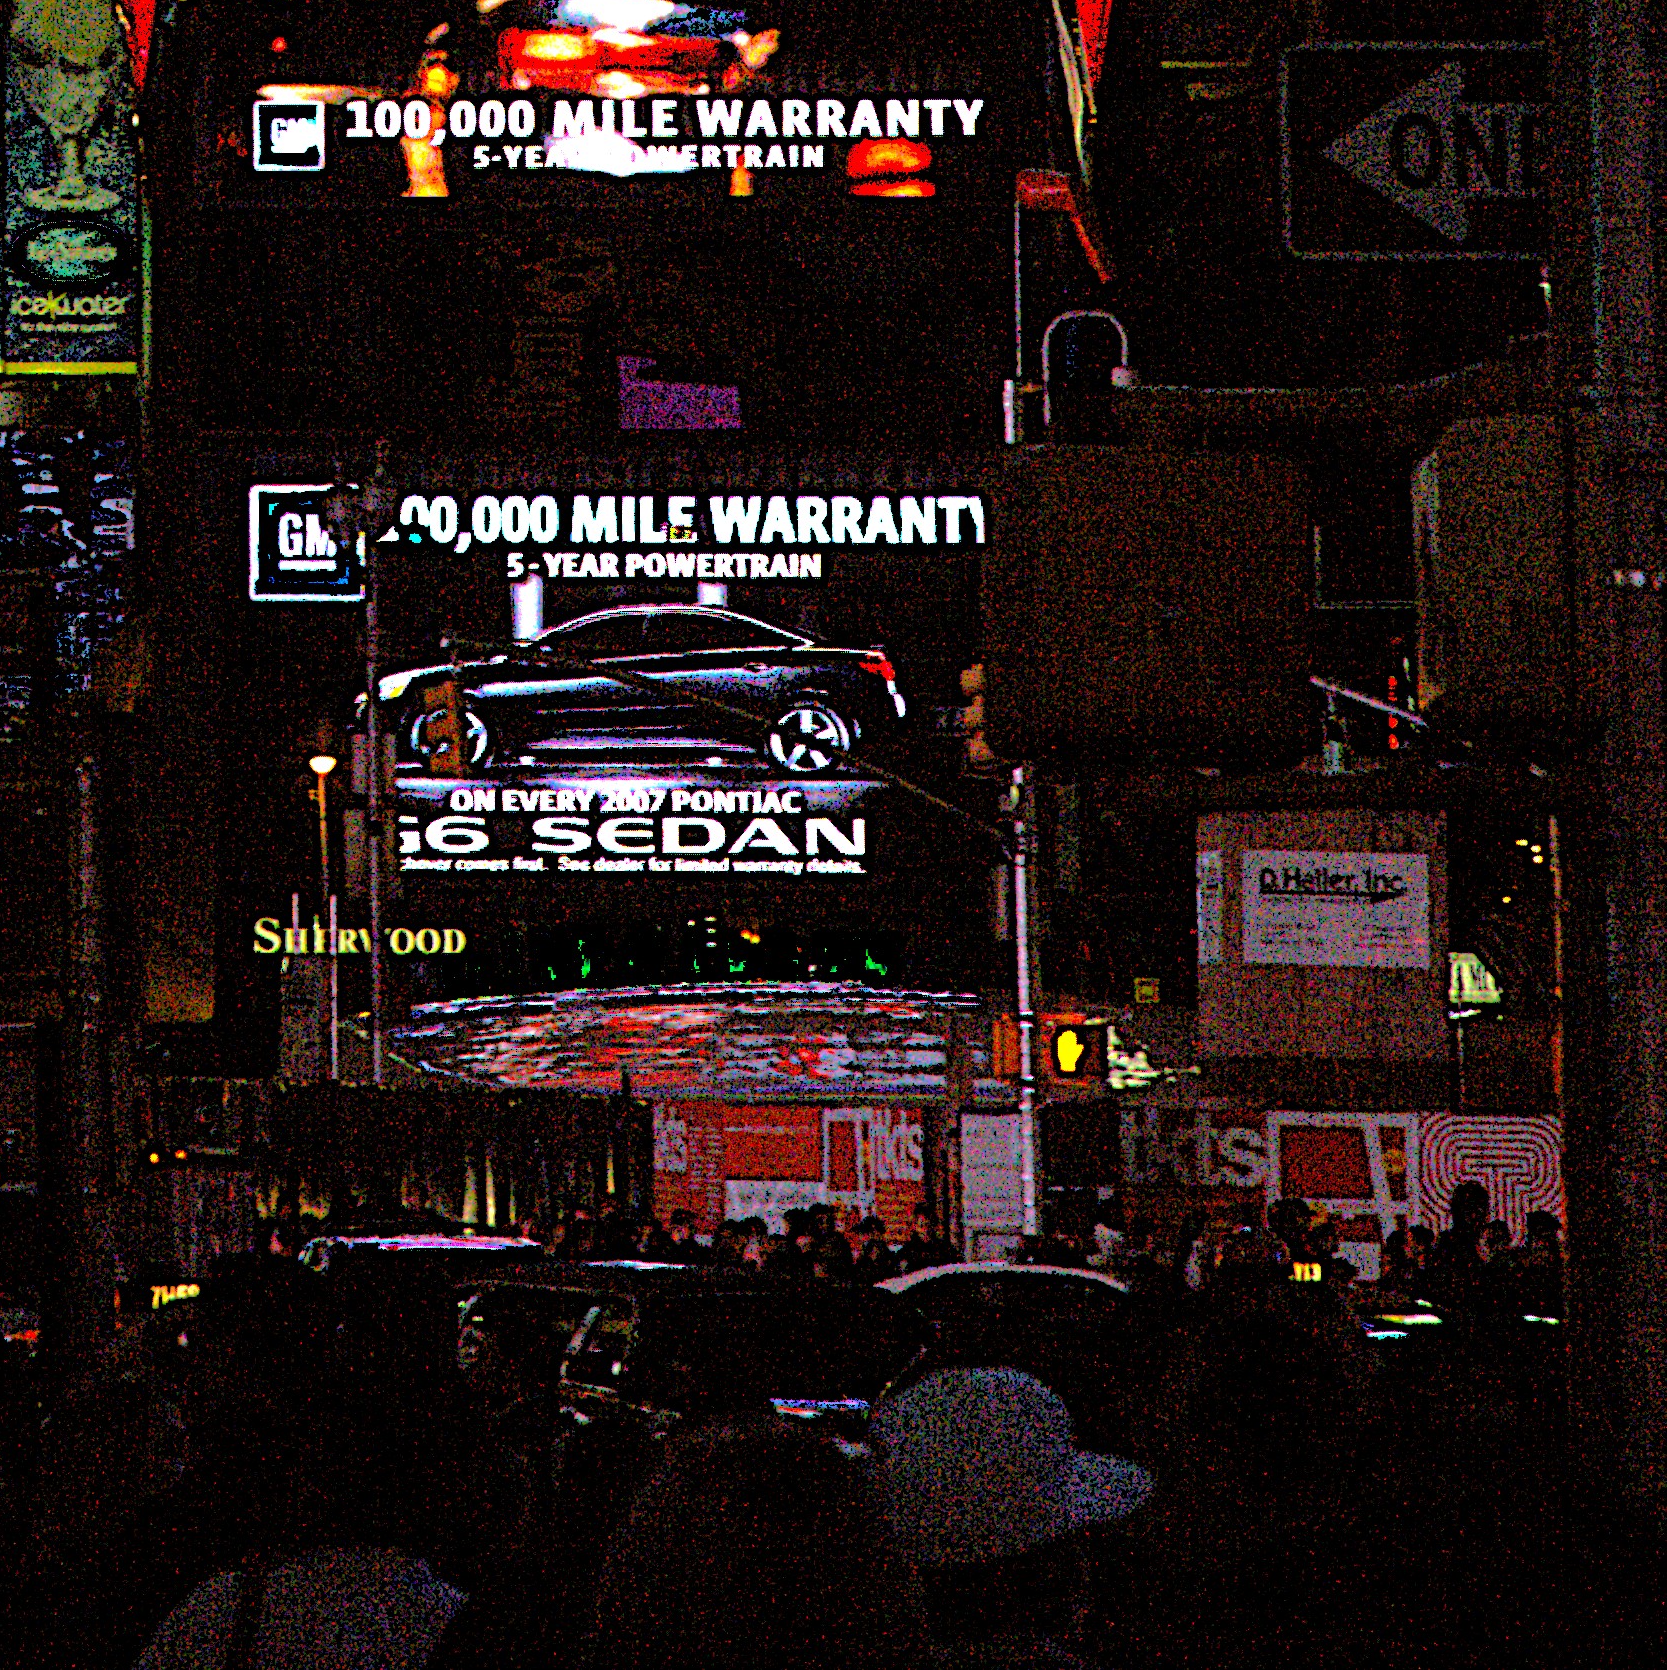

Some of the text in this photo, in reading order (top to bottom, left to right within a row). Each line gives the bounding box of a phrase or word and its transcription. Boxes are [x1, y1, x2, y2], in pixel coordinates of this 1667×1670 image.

[345, 99, 985, 147] 100,000 MILE WARRANTY
[473, 144, 589, 169] 5-YEA
[376, 494, 559, 554] 00,000
[572, 495, 698, 544] MILE
[624, 553, 822, 579] POWERTRAIN
[450, 789, 802, 814] ON EVERY 2007 PONTIAC
[532, 816, 866, 856] SEDAN
